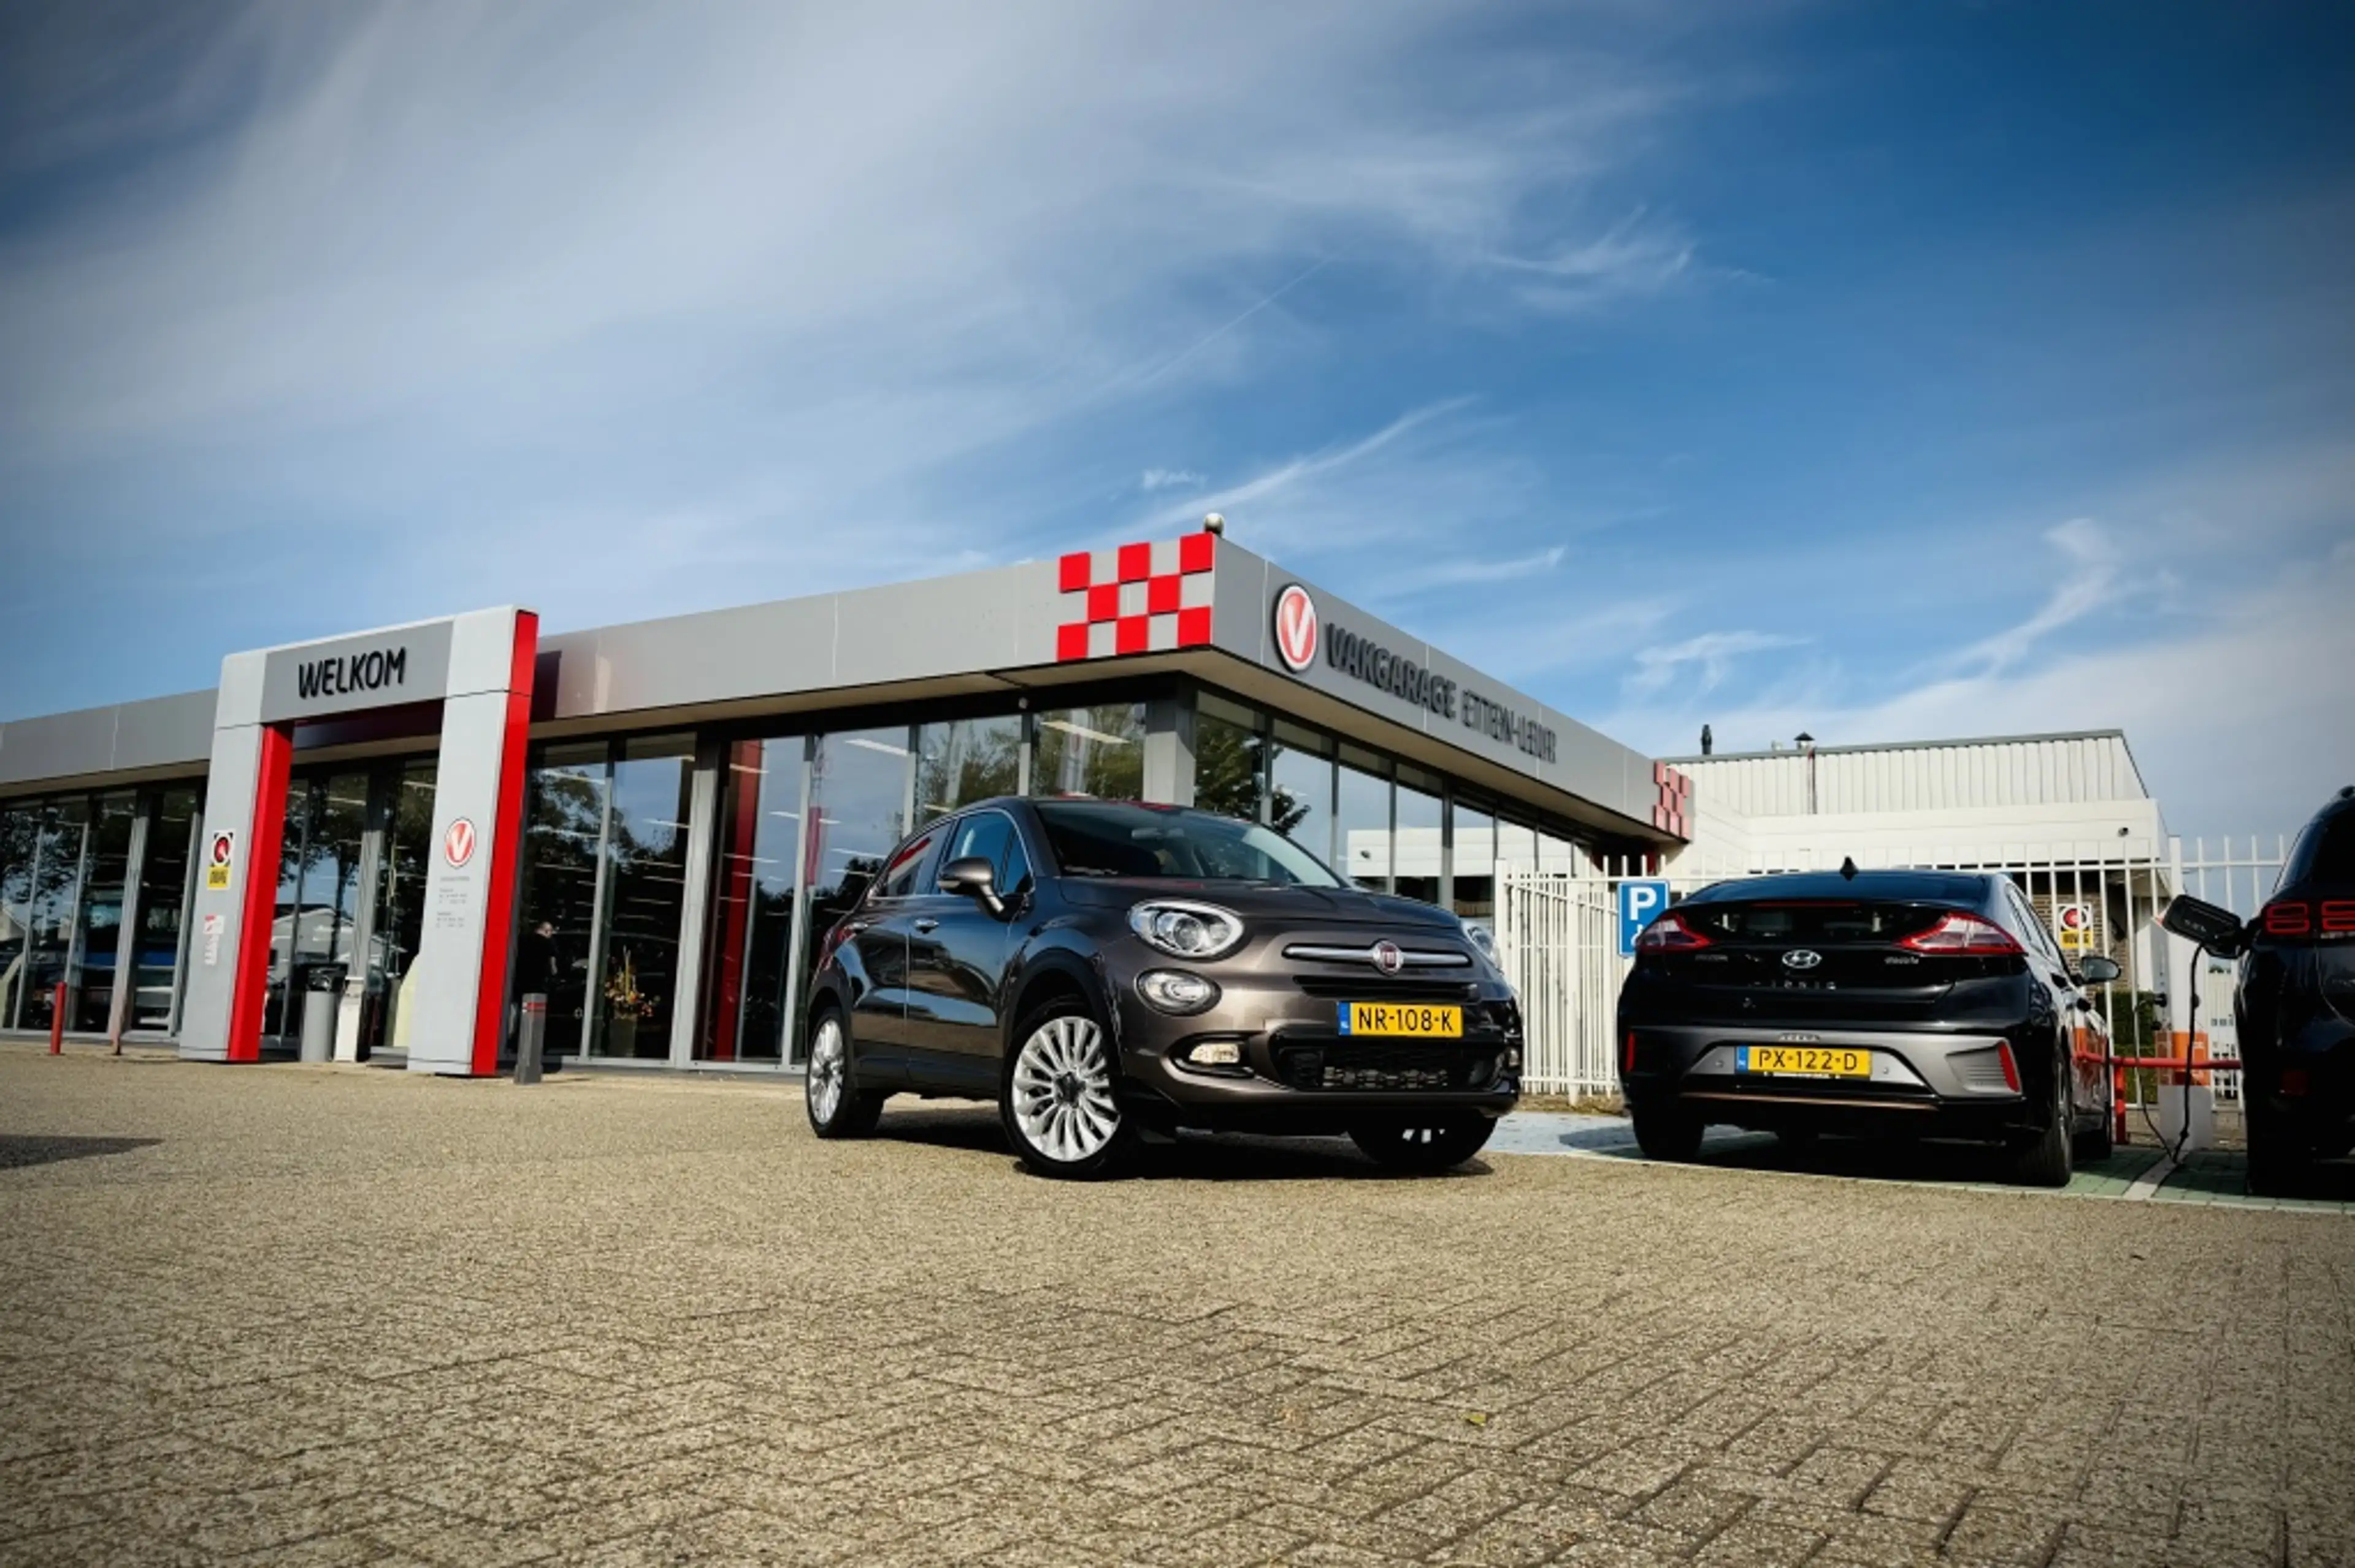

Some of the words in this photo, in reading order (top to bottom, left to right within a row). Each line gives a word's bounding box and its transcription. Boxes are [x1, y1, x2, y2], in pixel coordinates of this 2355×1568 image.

[299, 646, 406, 699] WELKOM
[1325, 622, 1457, 720] VAKGARAGE
[1630, 887, 1656, 920] P
[1358, 1007, 1453, 1032] NR-108-K
[1759, 1049, 1858, 1071] PX-122-D
